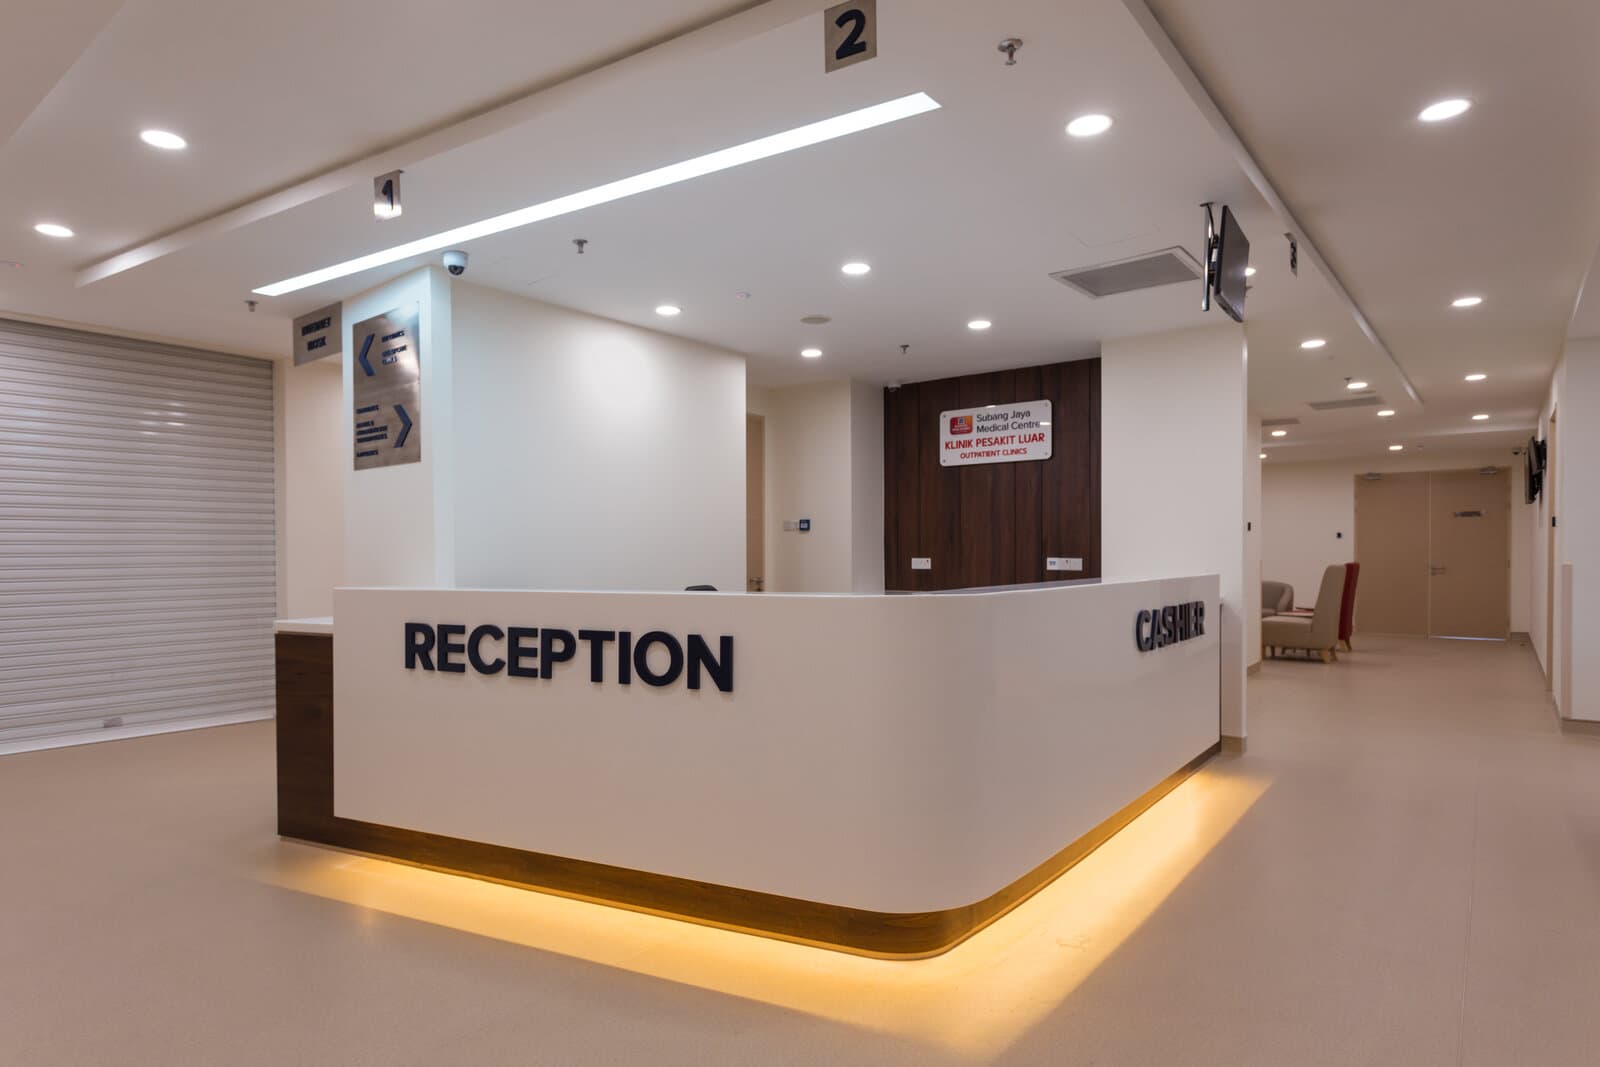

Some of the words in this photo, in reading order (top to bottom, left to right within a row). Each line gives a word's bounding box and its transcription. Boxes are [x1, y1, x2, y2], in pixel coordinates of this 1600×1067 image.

[835, 9, 866, 60] 2
[382, 179, 394, 210] 1
[976, 411, 1009, 422] Subang
[1010, 410, 1031, 420] Jaya
[976, 422, 1009, 433] Medical
[945, 439, 973, 451] KLINIK
[976, 435, 1016, 447] PESAKIT
[1018, 432, 1045, 444] LUAR
[960, 449, 1001, 459] OUTPATIENT
[1002, 447, 1028, 456] CLINICS
[1135, 600, 1205, 652] CASHIER
[404, 622, 734, 692] RECEPTION
